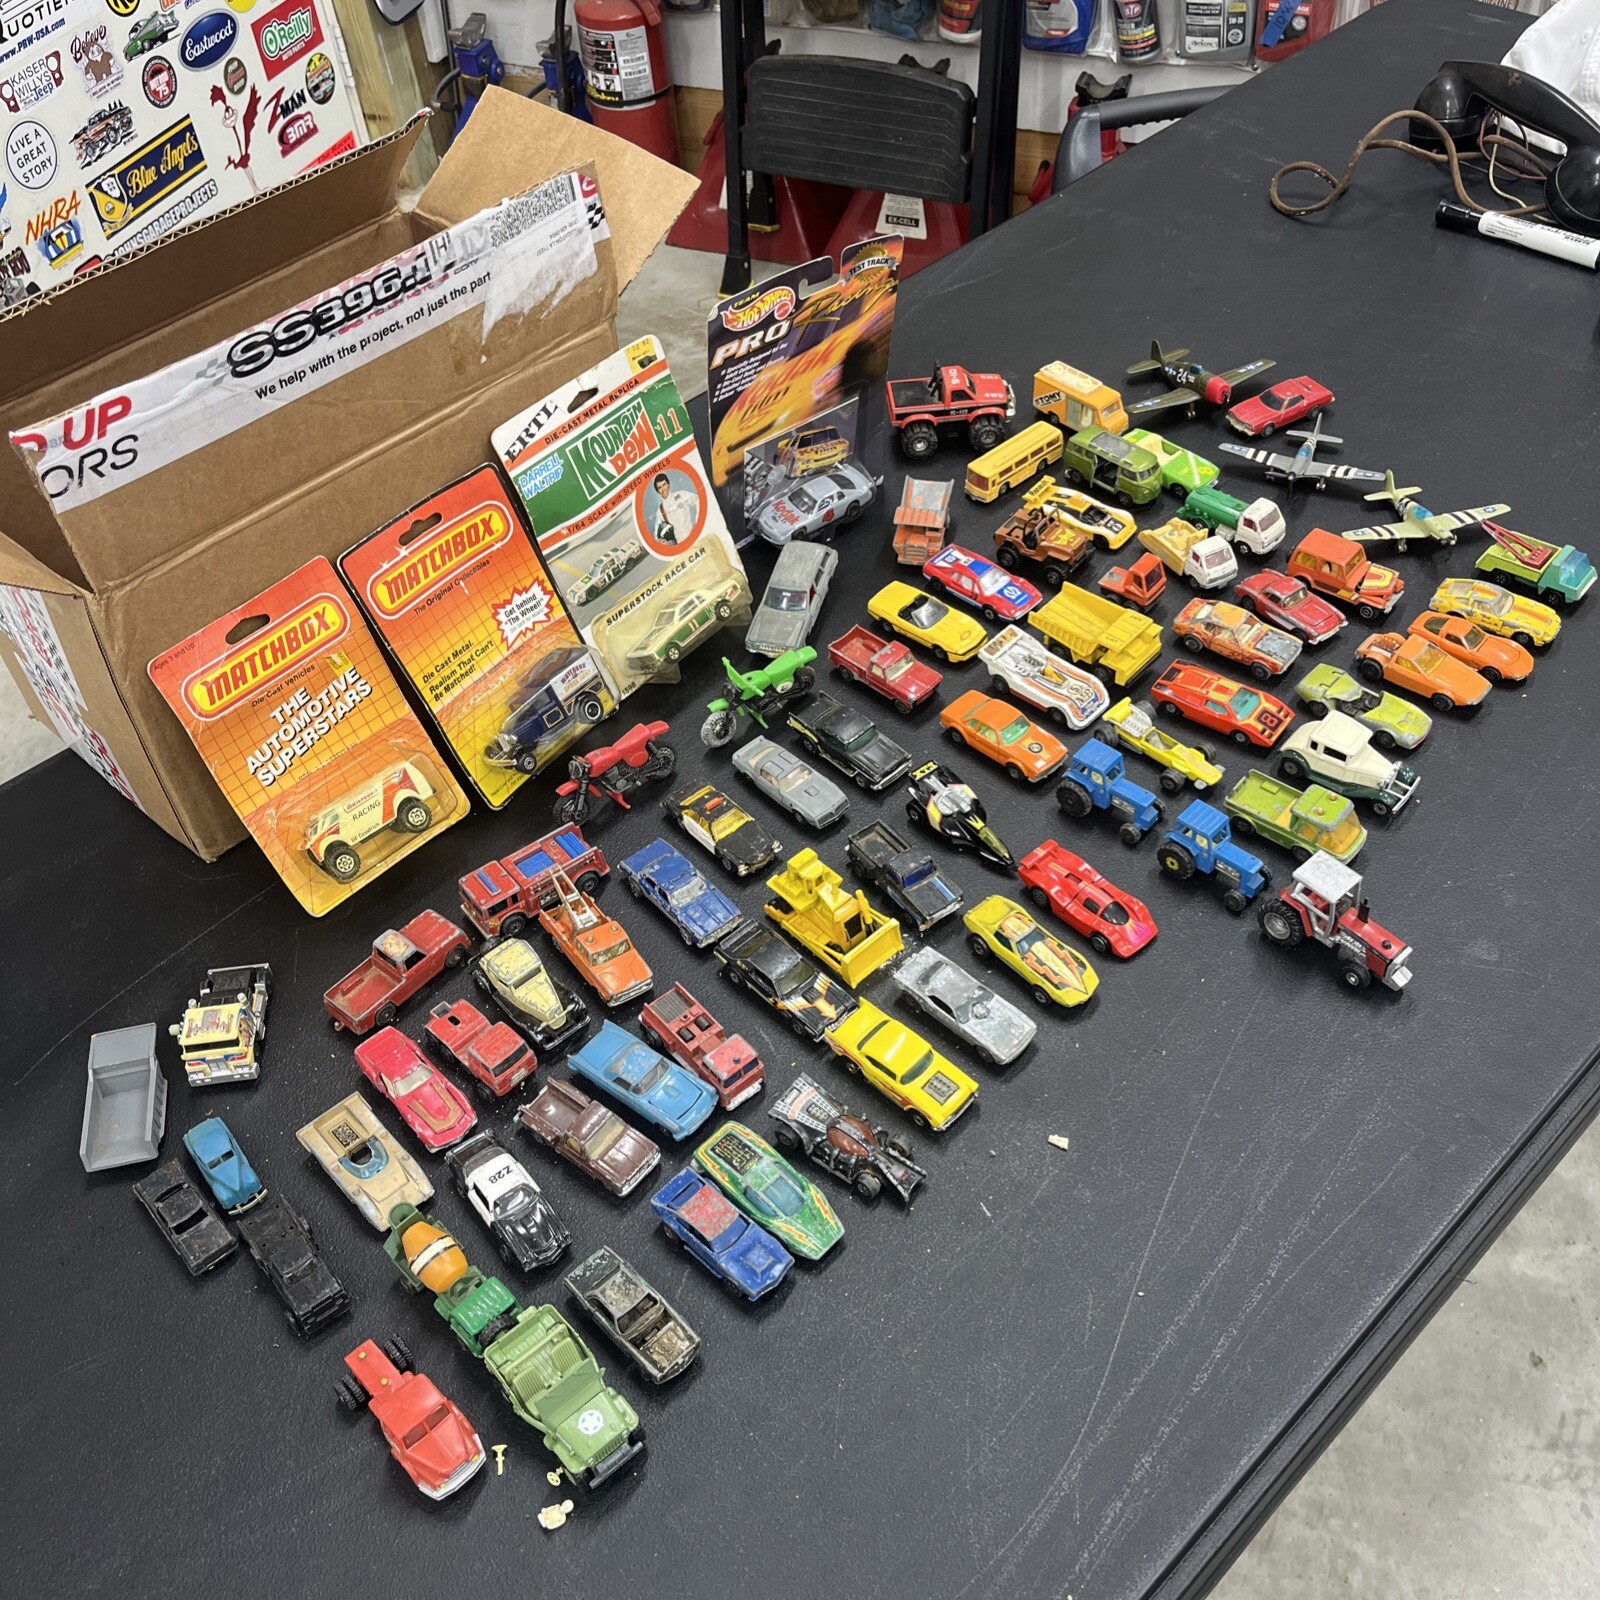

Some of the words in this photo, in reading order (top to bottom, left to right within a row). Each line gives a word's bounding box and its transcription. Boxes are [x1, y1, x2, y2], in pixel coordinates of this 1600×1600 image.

[1123, 5, 1139, 16] STP
[1228, 16, 1243, 24] 5W-30
[186, 19, 233, 61] Eastwood
[262, 9, 311, 57] O'Reilly
[10, 58, 46, 87] KAISER
[15, 71, 52, 98] WILLYS
[34, 82, 54, 101] Jeep
[156, 84, 169, 98] 75
[10, 134, 32, 154] LIVE
[34, 128, 41, 140] A
[17, 142, 47, 169] GREAT
[23, 156, 53, 183] STORY
[126, 165, 158, 198] Blue
[161, 132, 198, 175] Angels
[25, 191, 80, 245] NHRA
[849, 262, 866, 275] TEST
[867, 257, 890, 267] TRACK
[734, 291, 760, 308] TEAM
[737, 301, 766, 328] HOT
[763, 290, 793, 314] WHEELS
[255, 384, 277, 400] We
[279, 370, 307, 390] help
[309, 355, 335, 373] with
[337, 344, 358, 360] the
[359, 321, 405, 351] project,
[405, 307, 424, 325] not
[426, 295, 449, 317] just
[450, 286, 468, 301] the
[470, 271, 492, 293] part
[711, 320, 791, 370] PRO
[1176, 368, 1188, 384] 24
[545, 416, 582, 445] DIE-CAST
[583, 400, 608, 420] METAL
[609, 378, 641, 403] REPLICA
[1039, 391, 1061, 404] TOMY
[63, 395, 132, 451] UP
[504, 402, 558, 463] ERTL
[815, 446, 837, 455] film
[519, 452, 564, 488] DARRELL
[523, 467, 564, 500] WALTRIP
[567, 522, 586, 534] 1/64
[588, 504, 609, 524] SCALE
[611, 494, 622, 506] with
[623, 477, 643, 496] SPEED
[643, 458, 672, 479] WHEELS
[772, 499, 800, 526] Kodak
[822, 508, 834, 523] 4
[382, 513, 496, 606] MATCHBOX
[426, 583, 454, 606] Original
[454, 559, 491, 585] Collectibles
[606, 580, 663, 627] SUPERSTOCK
[665, 562, 687, 583] RACE
[688, 547, 707, 563] CAR
[504, 608, 516, 619] Get
[516, 593, 538, 611] behind
[689, 617, 700, 631] 11
[153, 659, 169, 672] Ages
[174, 648, 186, 659] and
[185, 643, 195, 654] Up
[200, 606, 331, 706] MATCHBOX
[422, 671, 435, 684] Die
[435, 656, 452, 673] Cast
[452, 640, 475, 660] Metal.
[429, 669, 457, 695] Realism
[457, 654, 475, 671] That
[475, 640, 494, 657] Can't
[285, 664, 316, 687] Vehicles
[433, 690, 443, 702] Be
[443, 665, 477, 693] Matched!
[621, 682, 637, 697] 1598
[246, 665, 361, 775] AUTOMOTIVE
[270, 686, 312, 725] THE
[1261, 713, 1279, 727] 8
[257, 679, 373, 786] SUPERSTARS
[352, 799, 381, 821] RACING
[488, 1165, 513, 1184] Z28
